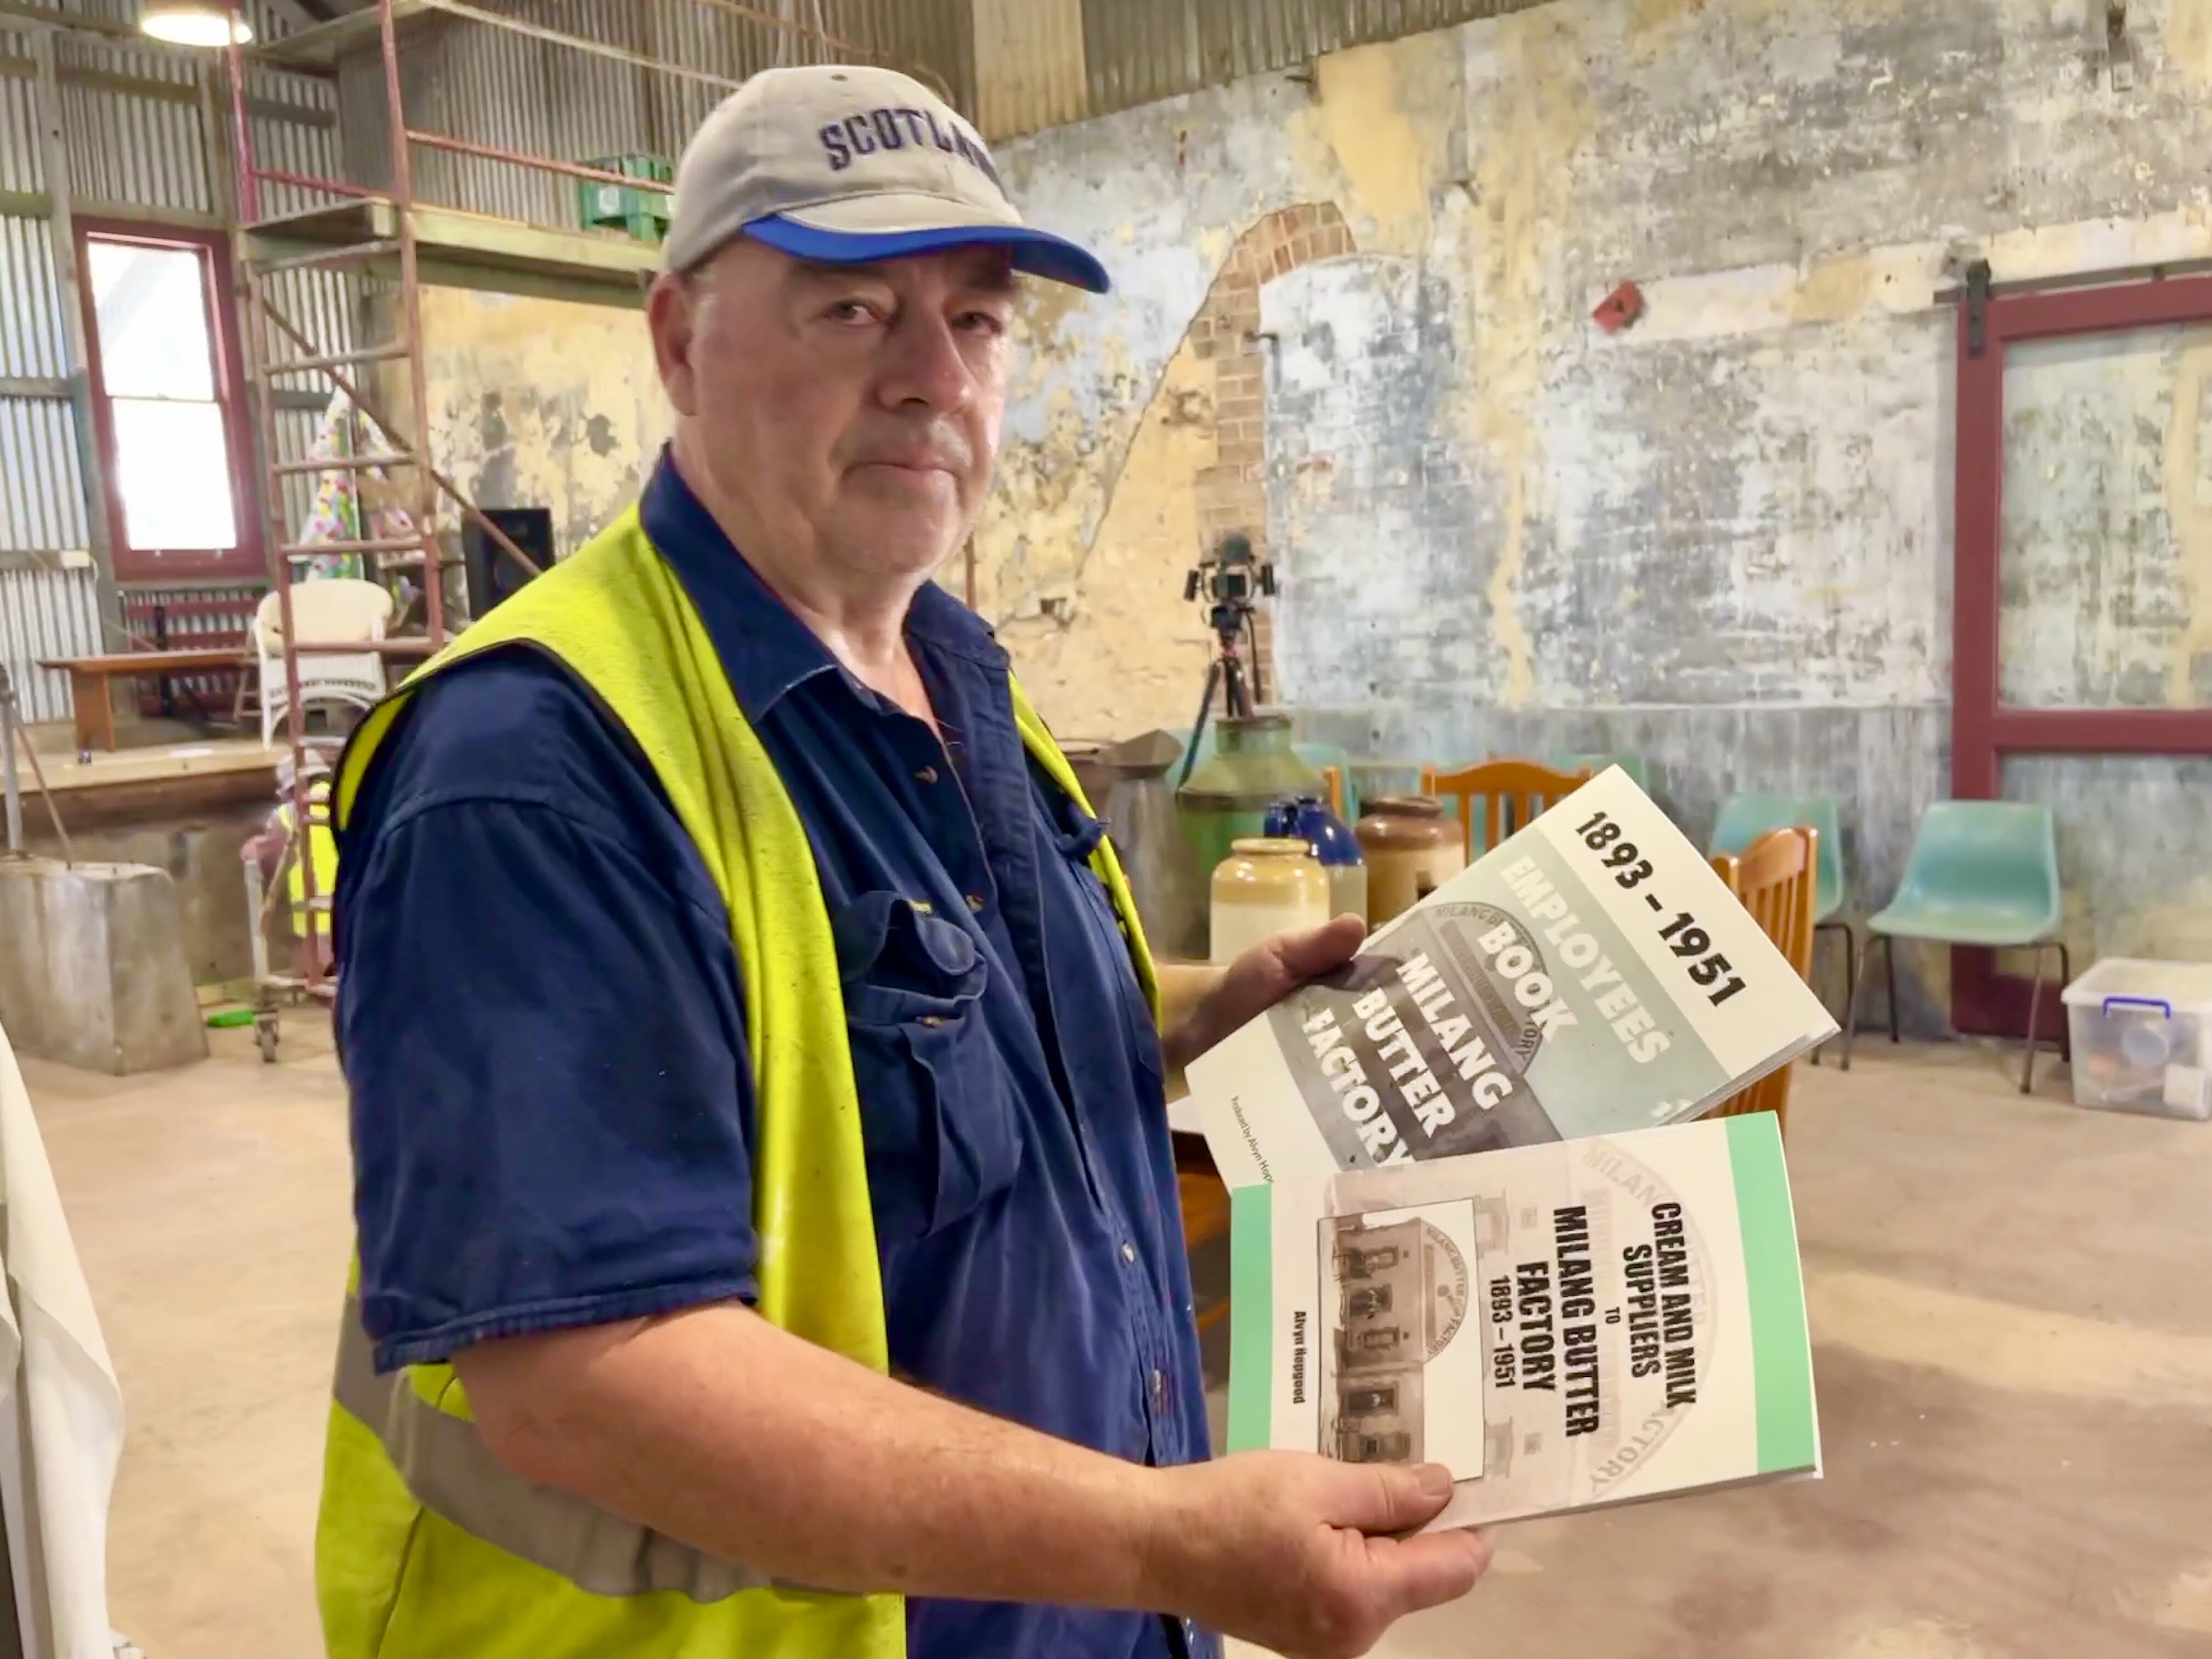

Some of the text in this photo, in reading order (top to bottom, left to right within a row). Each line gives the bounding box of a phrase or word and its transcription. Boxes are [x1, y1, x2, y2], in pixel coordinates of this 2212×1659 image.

[1499, 853, 1671, 1064] EMPLOYEES
[1575, 811, 1654, 889] 1893
[1657, 911, 1747, 1008] 1951
[1395, 952, 1513, 1110] MILANG
[1478, 921, 1579, 1043] BOOK
[1301, 1007, 1417, 1168] FACTORY
[1351, 986, 1457, 1139] BUTTER
[1259, 1159, 1274, 1183] Hop
[1293, 1311, 1307, 1345] Alvyn
[1489, 1275, 1513, 1324] 1893
[1493, 1342, 1516, 1389] 1951
[1516, 1261, 1557, 1393] FACTORY
[1553, 1205, 1600, 1437] MILANG BUTTER
[1604, 1306, 1621, 1325] TO
[1622, 1244, 1662, 1379] SUPPLIERS
[1651, 1201, 1697, 1409] CREAM AND MILK
